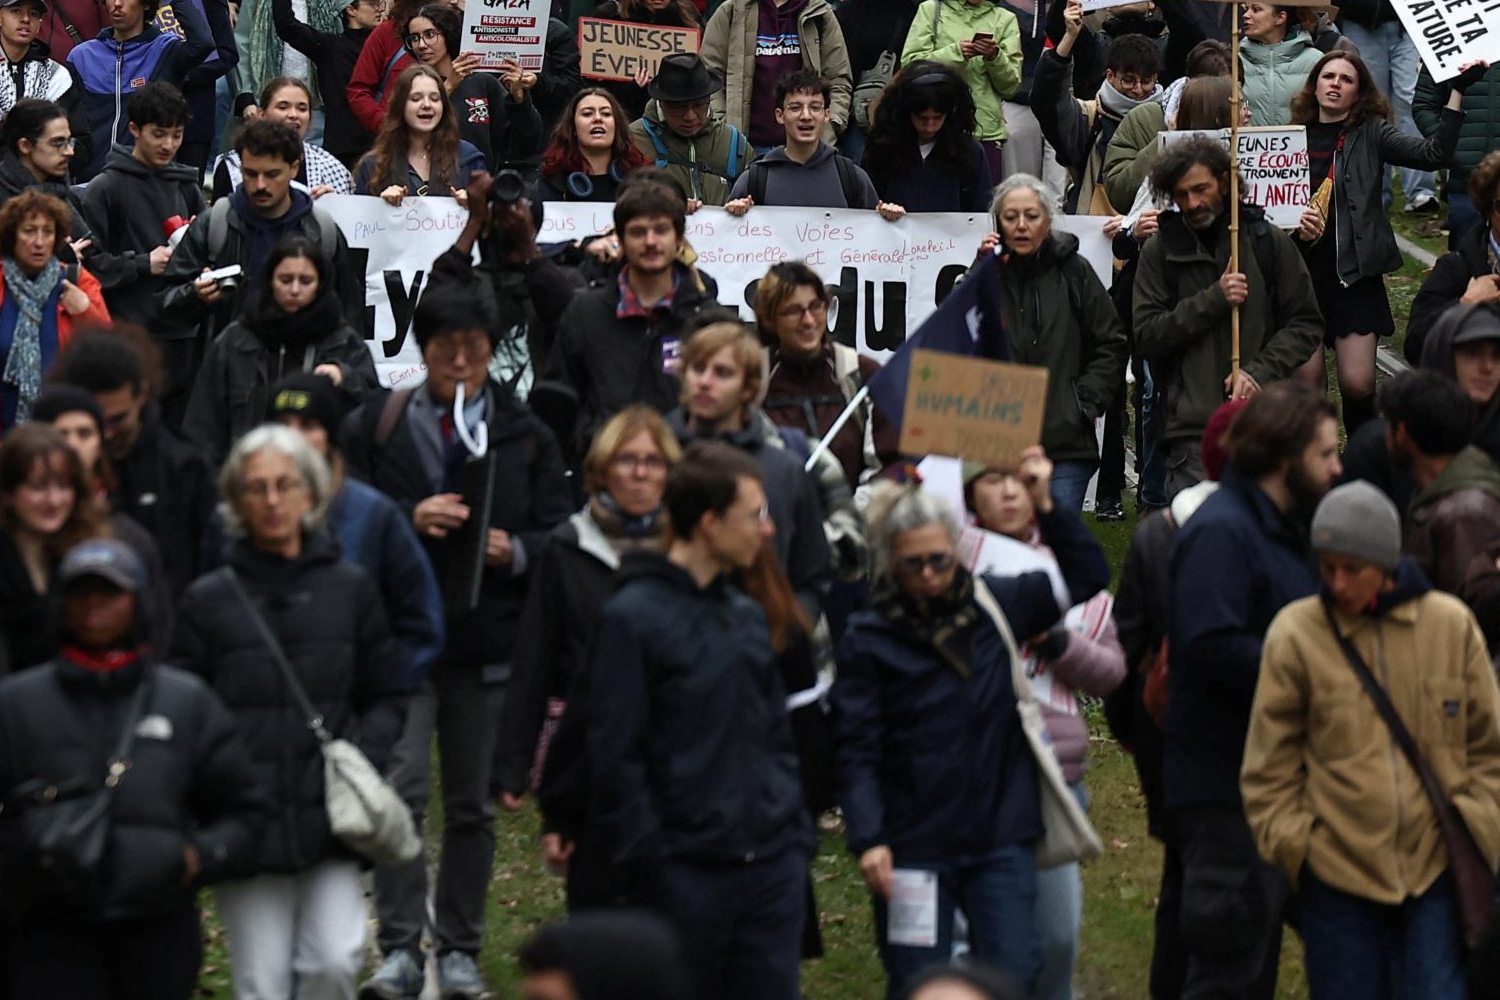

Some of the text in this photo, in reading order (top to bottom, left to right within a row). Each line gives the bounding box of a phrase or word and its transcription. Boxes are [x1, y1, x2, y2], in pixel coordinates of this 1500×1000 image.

[473, 26, 516, 34] ANTISIONISTE
[478, 35, 538, 44] ANTICOLONIALISTE
[583, 20, 688, 53] JEUNESSE
[1456, 12, 1489, 45] TA
[1238, 149, 1309, 168] RE ÉCOUTÉS
[1244, 168, 1309, 180] TROUVENT
[1247, 178, 1310, 209] LANTÉS.
[354, 221, 387, 241] PAUL
[542, 216, 577, 233] ous
[684, 221, 716, 237] ens
[738, 220, 773, 238] des
[796, 222, 855, 243] Voies
[696, 246, 789, 265] ssionnelle
[804, 247, 826, 266] et
[824, 265, 908, 352] du
[915, 391, 1024, 426] HUMAINS
